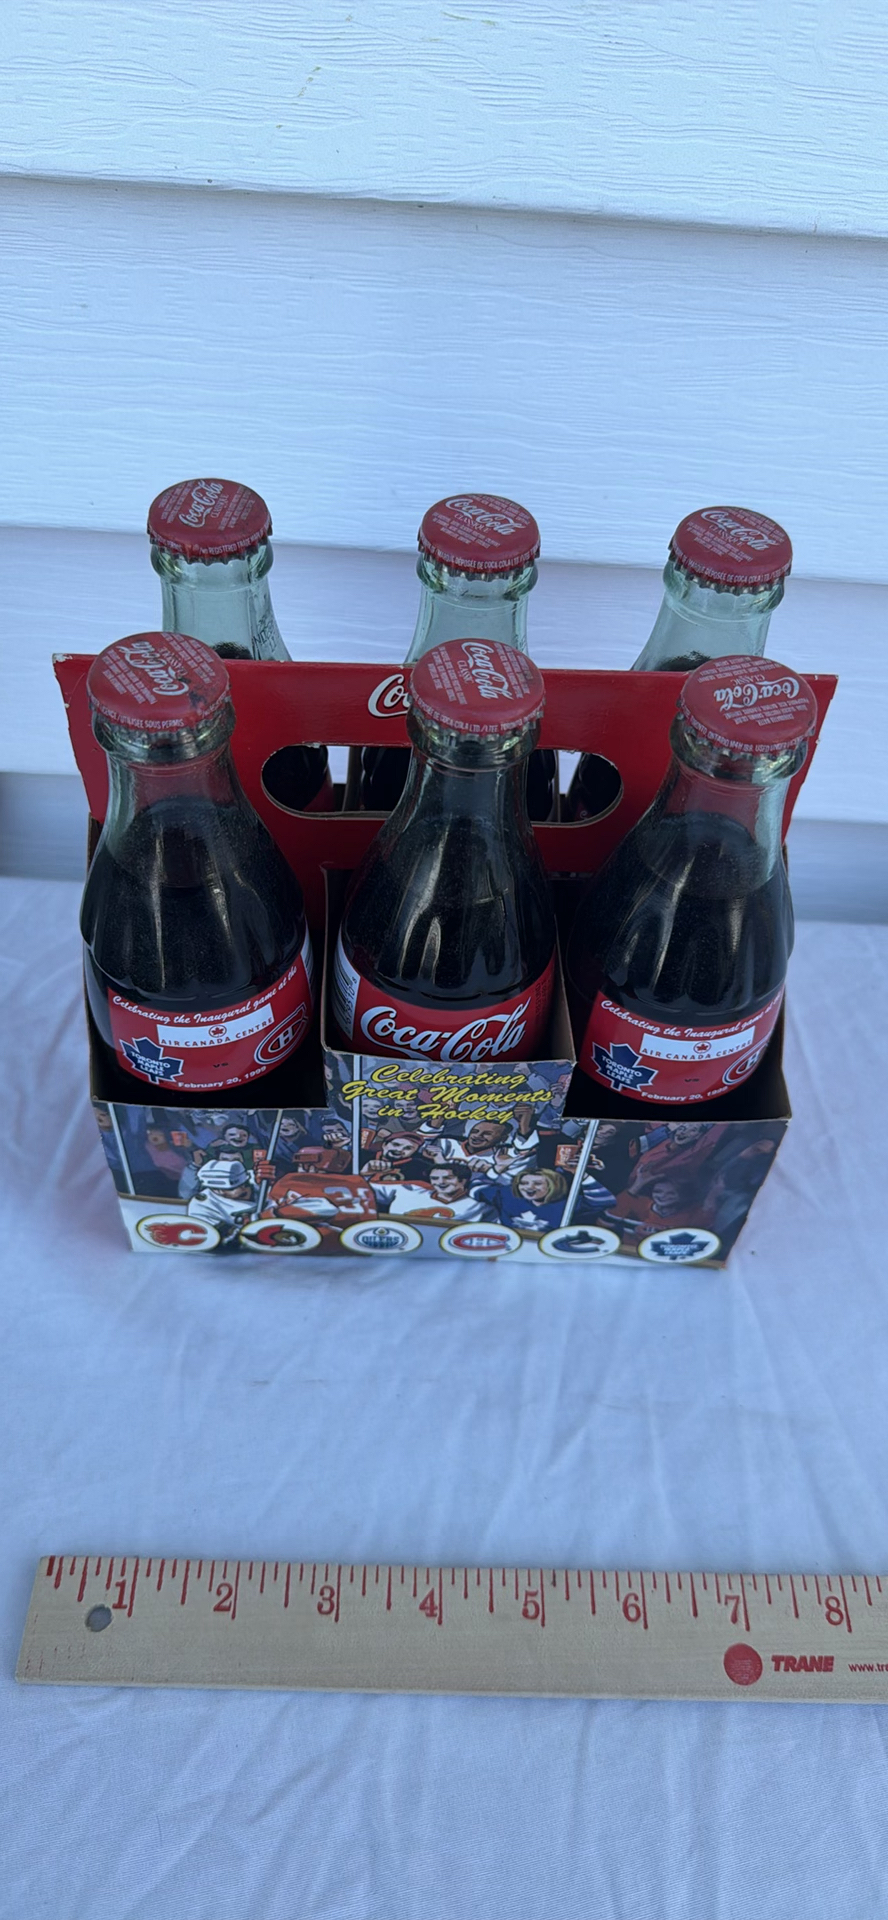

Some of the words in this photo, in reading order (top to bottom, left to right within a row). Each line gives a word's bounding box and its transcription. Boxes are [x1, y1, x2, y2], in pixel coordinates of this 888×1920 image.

[179, 480, 224, 528] Coca-Cola
[445, 498, 526, 536] Coca-Cola
[701, 510, 780, 550] Coca-Cola
[115, 641, 190, 696] Coca-Cola
[461, 641, 513, 700] Coca-Cola
[714, 676, 800, 711] Coca-Cola
[113, 995, 171, 1024] Celebrating
[173, 1013, 191, 1024] the
[193, 1001, 251, 1024] Inaugural
[253, 988, 277, 1010] game
[278, 977, 287, 990] at
[288, 966, 297, 981] the
[160, 1039, 180, 1047] AIR
[184, 1036, 231, 1047] CANADA
[235, 1017, 272, 1039] CENTRE
[360, 997, 531, 1062] Coca-Cola
[601, 1000, 661, 1034] Celebrating
[663, 1027, 681, 1037] the
[684, 1021, 741, 1039] Inaugural
[741, 1011, 764, 1031] game
[130, 1051, 170, 1069] TORONTO
[642, 1048, 661, 1057] AIR
[716, 1039, 751, 1057] CENTRE
[137, 1059, 164, 1072] MAPLE
[140, 1064, 164, 1076] LEAFS
[178, 1081, 223, 1089] February
[226, 1077, 241, 1085] 20,
[244, 1066, 266, 1079] 1999
[371, 1064, 526, 1090] Celebrating
[602, 1055, 642, 1077] TORONTO
[606, 1064, 634, 1080] MAPLE
[607, 1070, 631, 1084] LEAFS
[341, 1080, 419, 1102] Great
[429, 1086, 554, 1104] Moments
[641, 1091, 687, 1101] February
[377, 1104, 404, 1118] in
[416, 1103, 515, 1124] Hockey
[112, 1579, 128, 1610] 1
[213, 1582, 233, 1612] 2
[317, 1585, 335, 1616] 3
[419, 1588, 438, 1618] 4
[522, 1590, 540, 1620] 5
[622, 1592, 642, 1623] 6
[725, 1594, 741, 1625] 7
[825, 1595, 843, 1626] 8
[771, 1655, 834, 1672] TRANE
